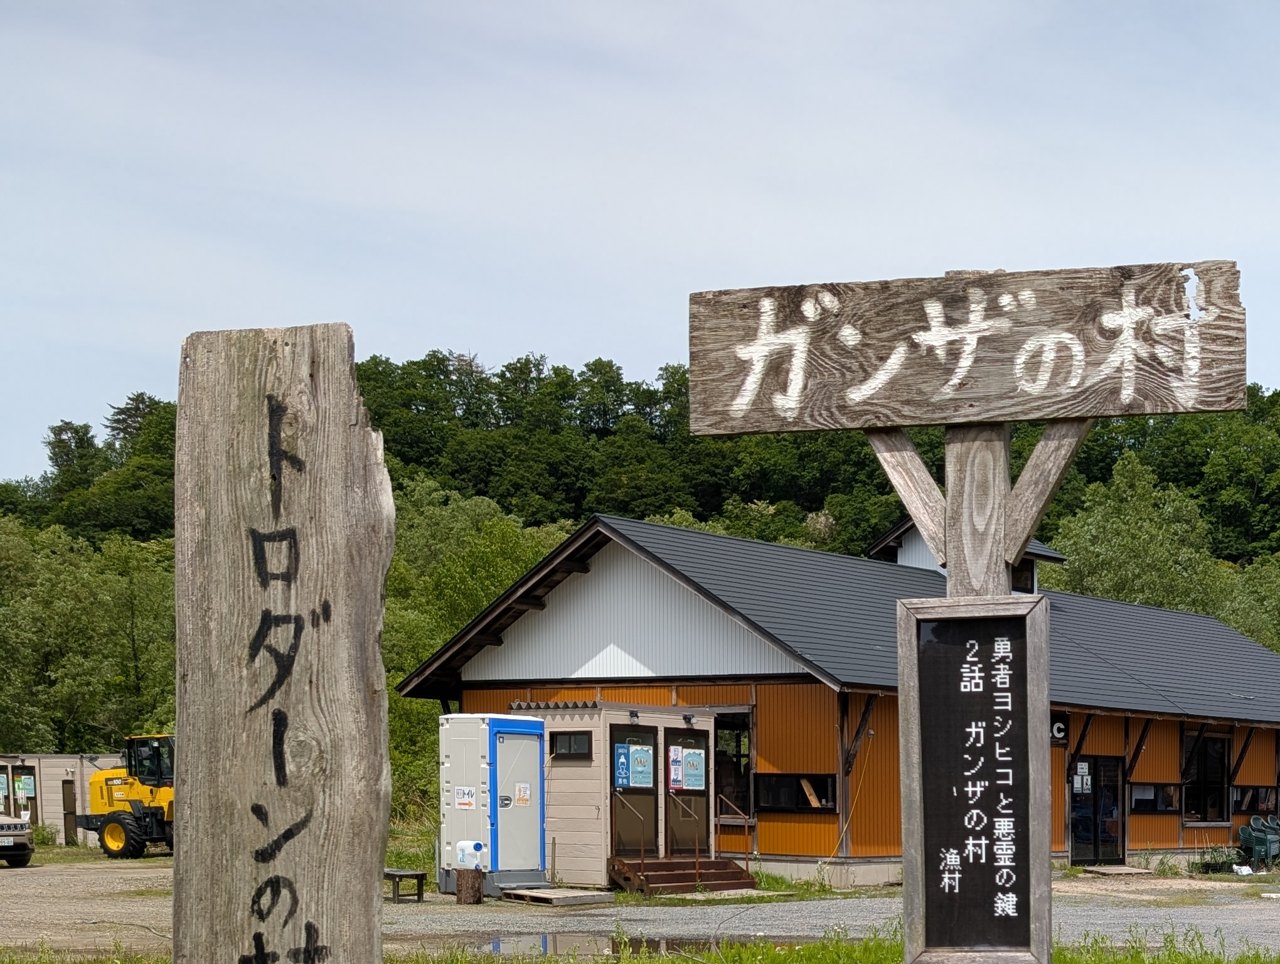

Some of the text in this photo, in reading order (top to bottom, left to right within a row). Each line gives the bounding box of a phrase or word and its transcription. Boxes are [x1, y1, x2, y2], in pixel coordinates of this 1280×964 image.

[730, 288, 1219, 421] ガンザの村
[960, 640, 990, 864] 2話 ガンザの村
[990, 637, 1019, 917] 勇者ヨシヒコと悪霊の鍵
[939, 847, 963, 894] 漁村
